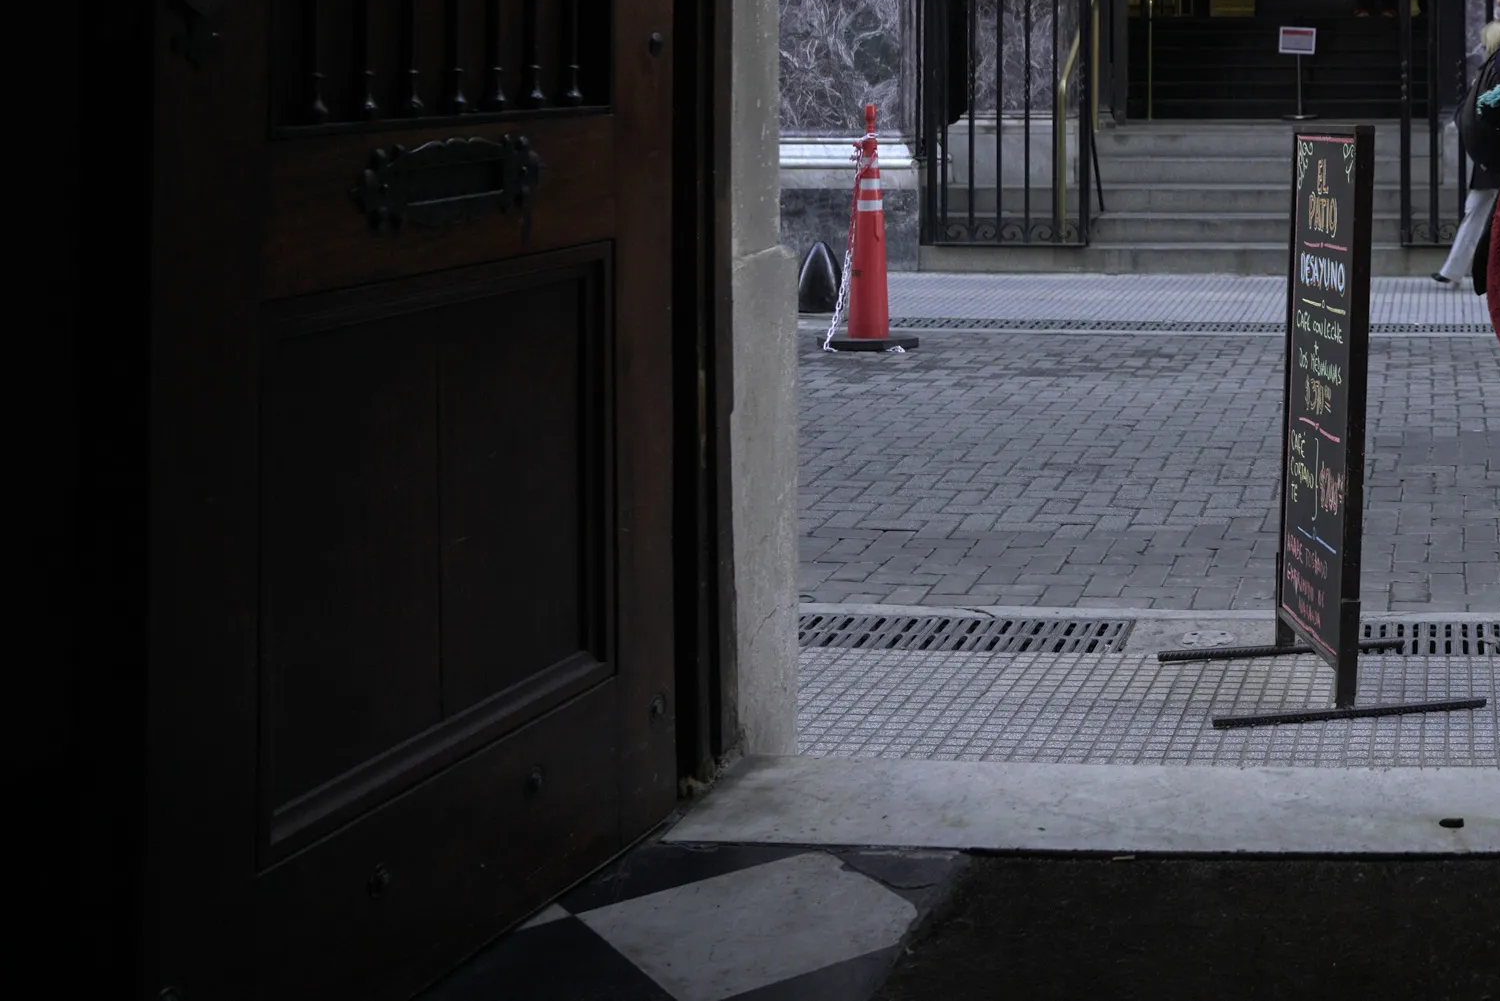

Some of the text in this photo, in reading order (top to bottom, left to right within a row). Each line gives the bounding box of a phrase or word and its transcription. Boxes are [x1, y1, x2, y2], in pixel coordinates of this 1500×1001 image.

[1316, 158, 1330, 195] EL
[1308, 191, 1338, 238] PATIO
[1299, 250, 1346, 297] DESAYUNO
